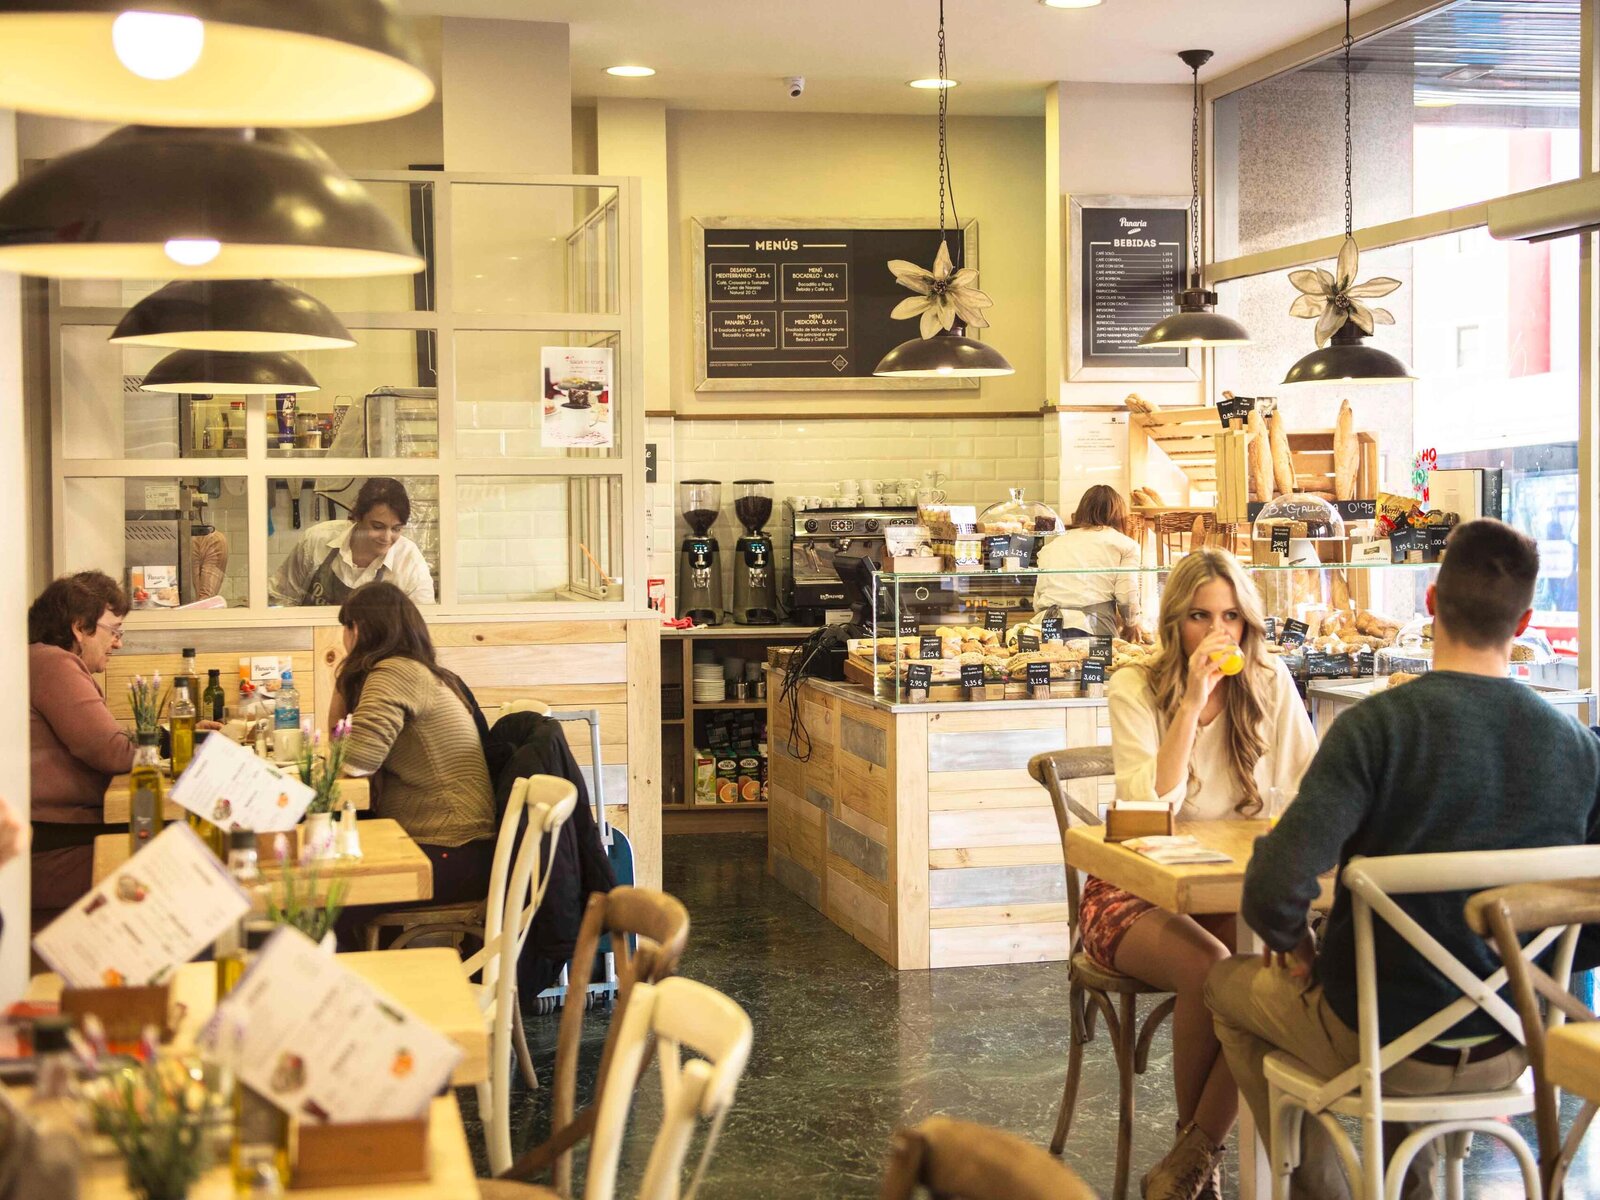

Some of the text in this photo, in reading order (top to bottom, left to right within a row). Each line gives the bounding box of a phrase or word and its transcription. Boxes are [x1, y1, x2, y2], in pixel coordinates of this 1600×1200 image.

[1119, 216, 1147, 227] Panaria
[755, 238, 798, 250] MENÚS
[1113, 238, 1157, 248] BEBIDAS
[992, 550, 1004, 558] 2,50
[1010, 548, 1023, 557] 1,25
